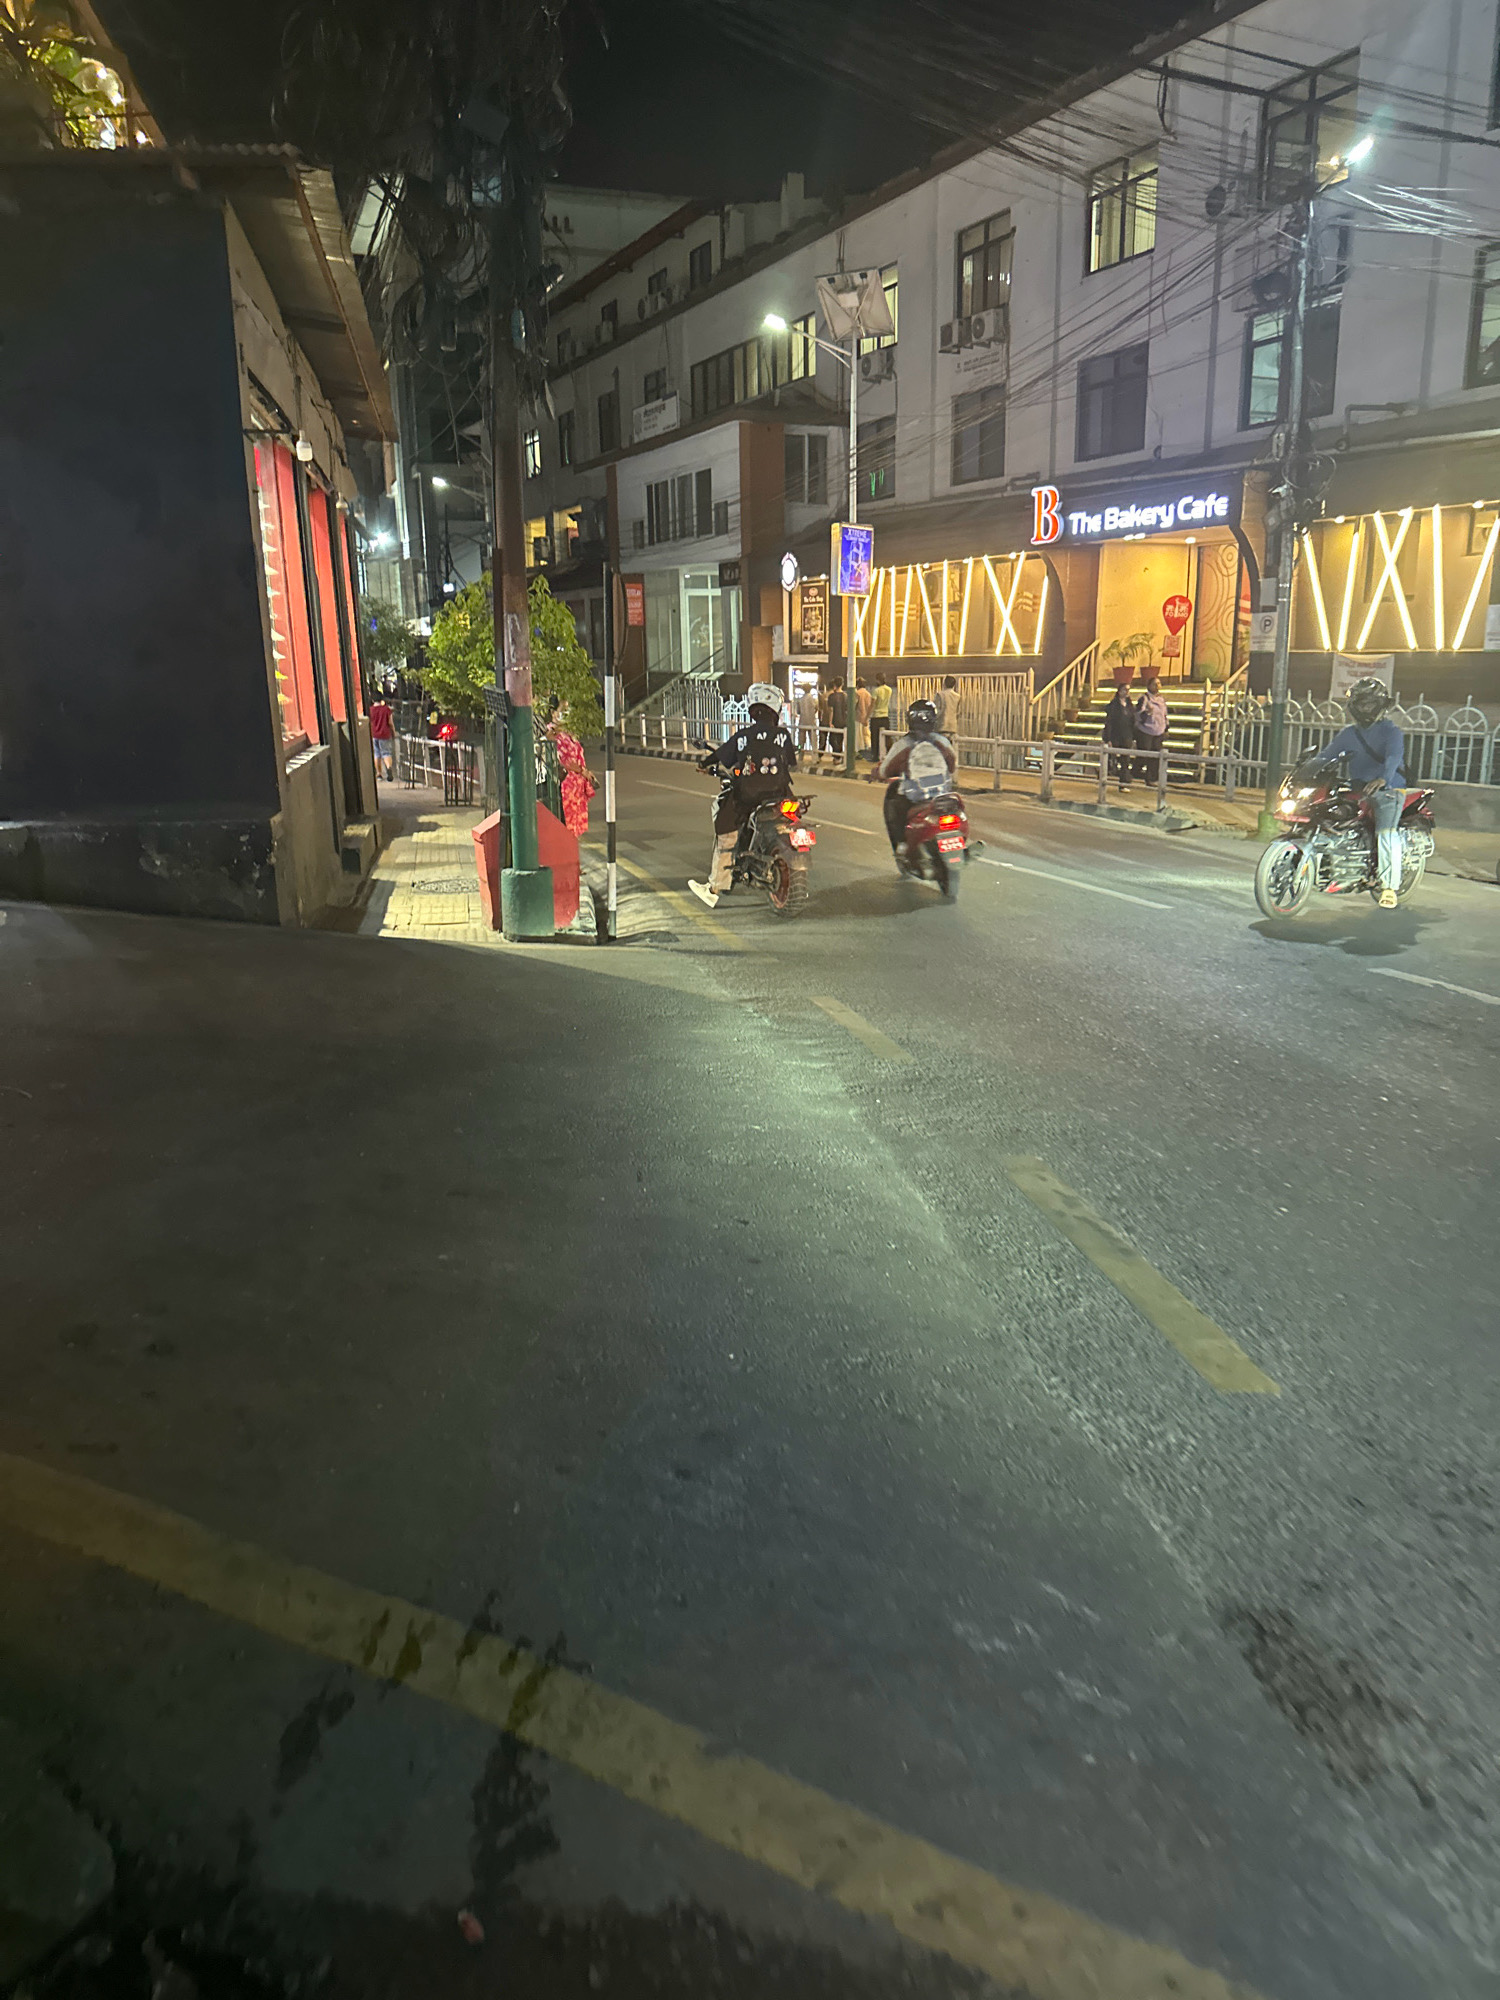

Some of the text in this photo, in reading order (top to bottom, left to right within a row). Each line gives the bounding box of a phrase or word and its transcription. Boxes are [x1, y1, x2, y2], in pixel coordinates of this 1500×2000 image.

[1031, 485, 1061, 545] B
[1069, 492, 1229, 535] The Bakery Cafe
